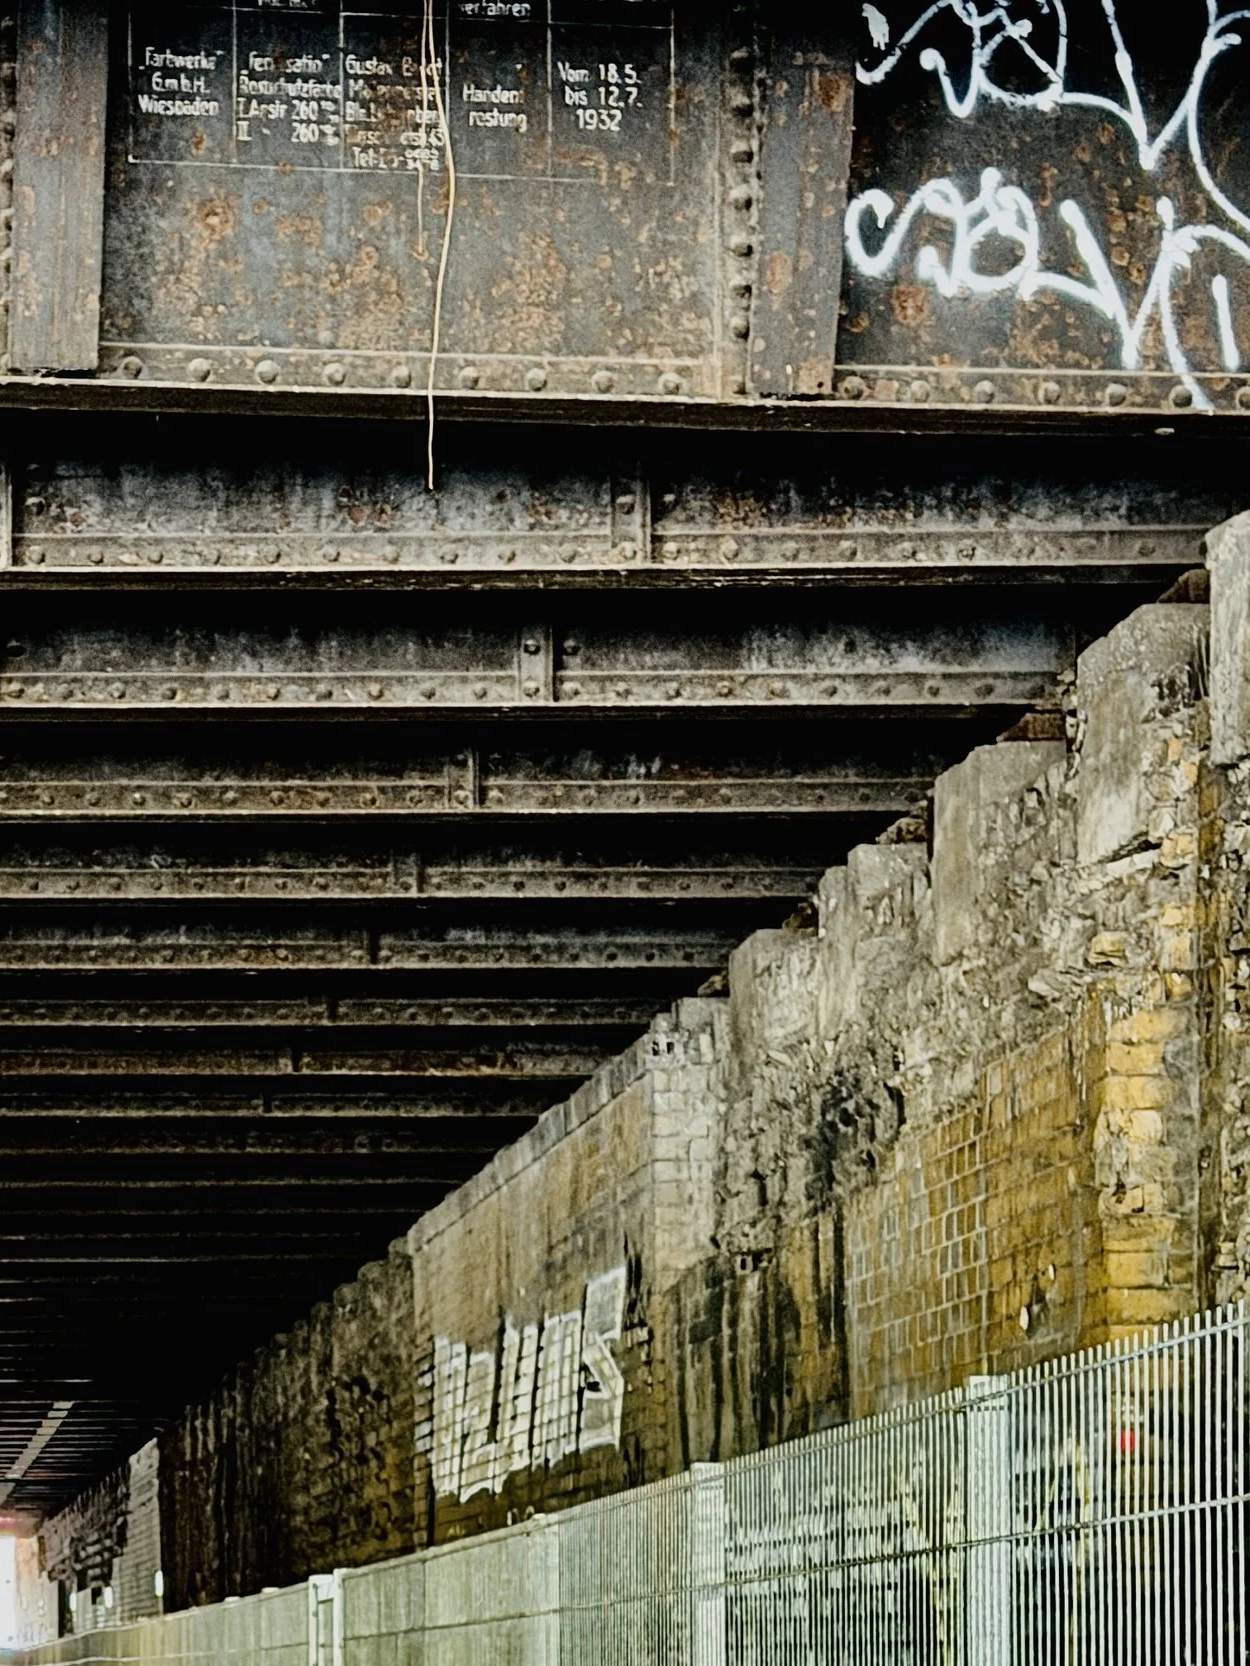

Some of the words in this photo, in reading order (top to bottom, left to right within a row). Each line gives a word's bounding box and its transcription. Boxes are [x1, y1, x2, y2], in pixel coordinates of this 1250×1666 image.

[138, 94, 219, 116] Wiesbaden
[291, 99, 319, 121] 260
[575, 108, 623, 131] 1932
[291, 121, 319, 143] 260
